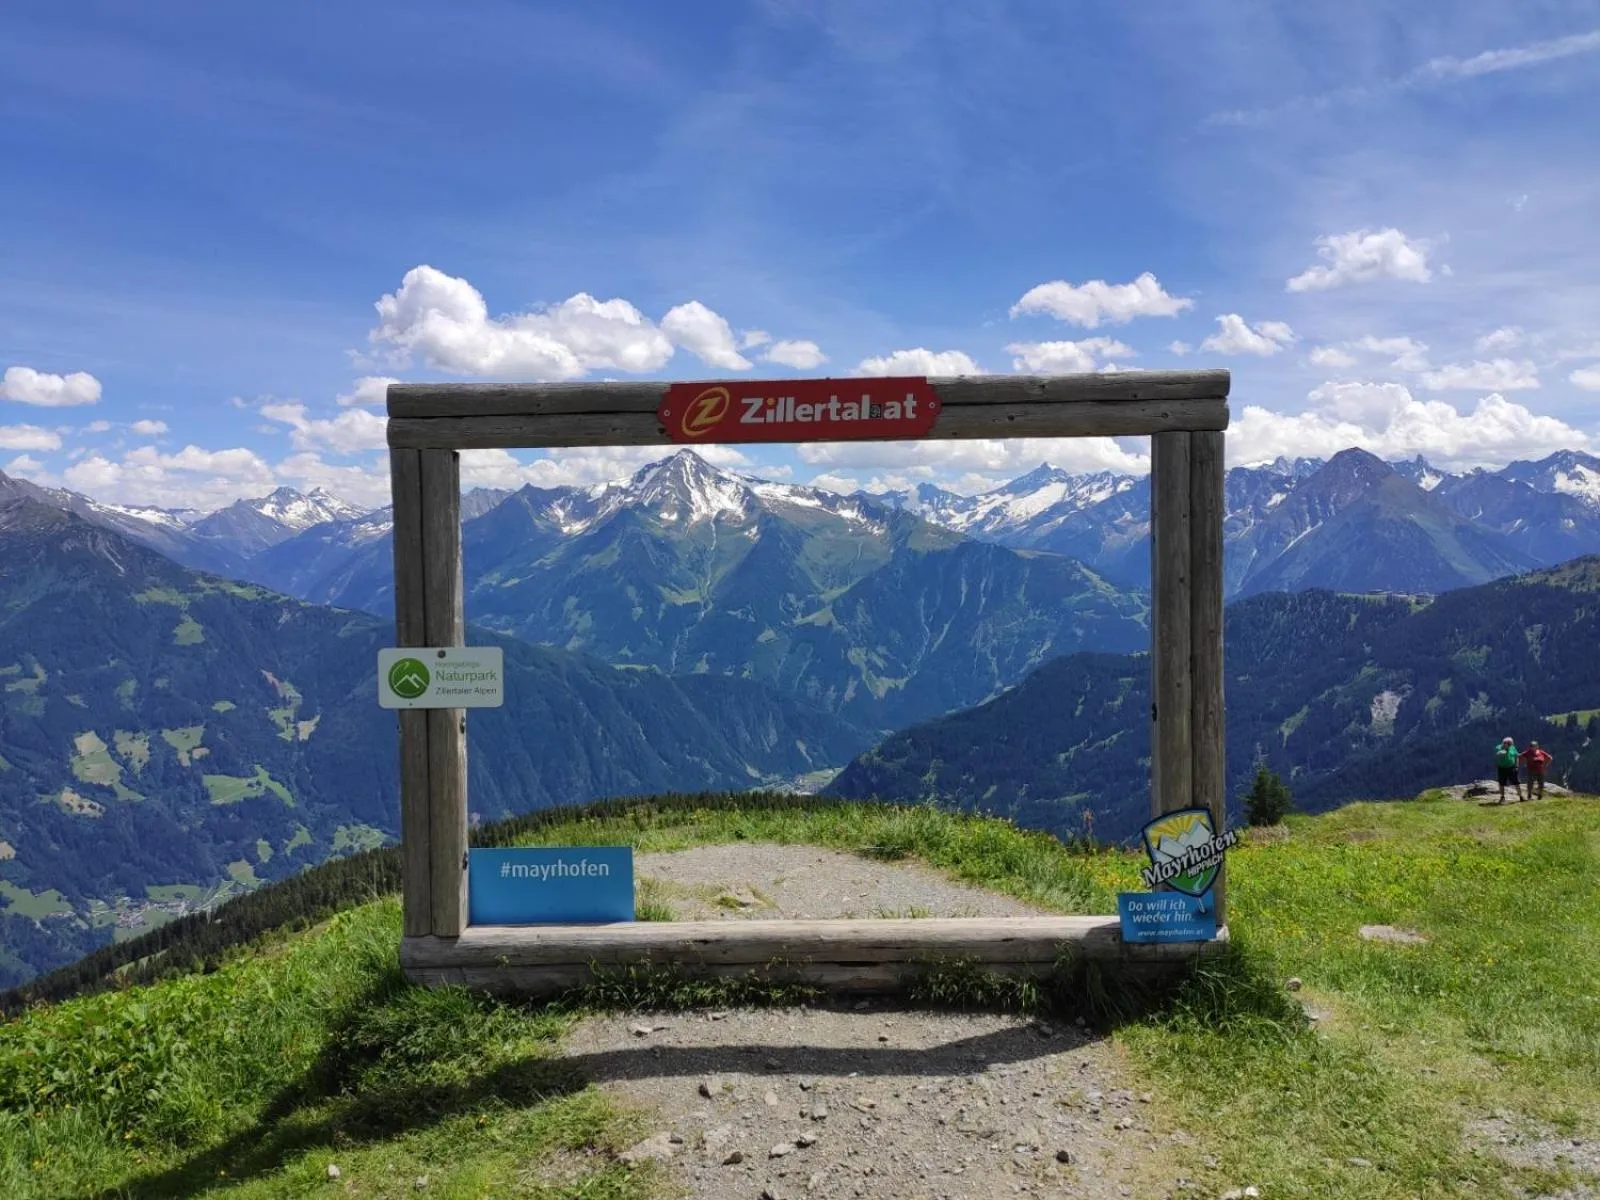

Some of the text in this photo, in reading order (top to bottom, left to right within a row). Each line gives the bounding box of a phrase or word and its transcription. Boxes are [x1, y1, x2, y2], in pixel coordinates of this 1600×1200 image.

[740, 394, 917, 423] Zillertalat
[436, 670, 497, 683] Naturpark
[435, 686, 497, 695] Zillertaler Alpen
[1143, 830, 1236, 888] Mayrhofen
[500, 859, 609, 882] #mayrhofen
[1147, 899, 1167, 912] will
[1169, 898, 1186, 911] ich
[1132, 911, 1172, 923] wieder
